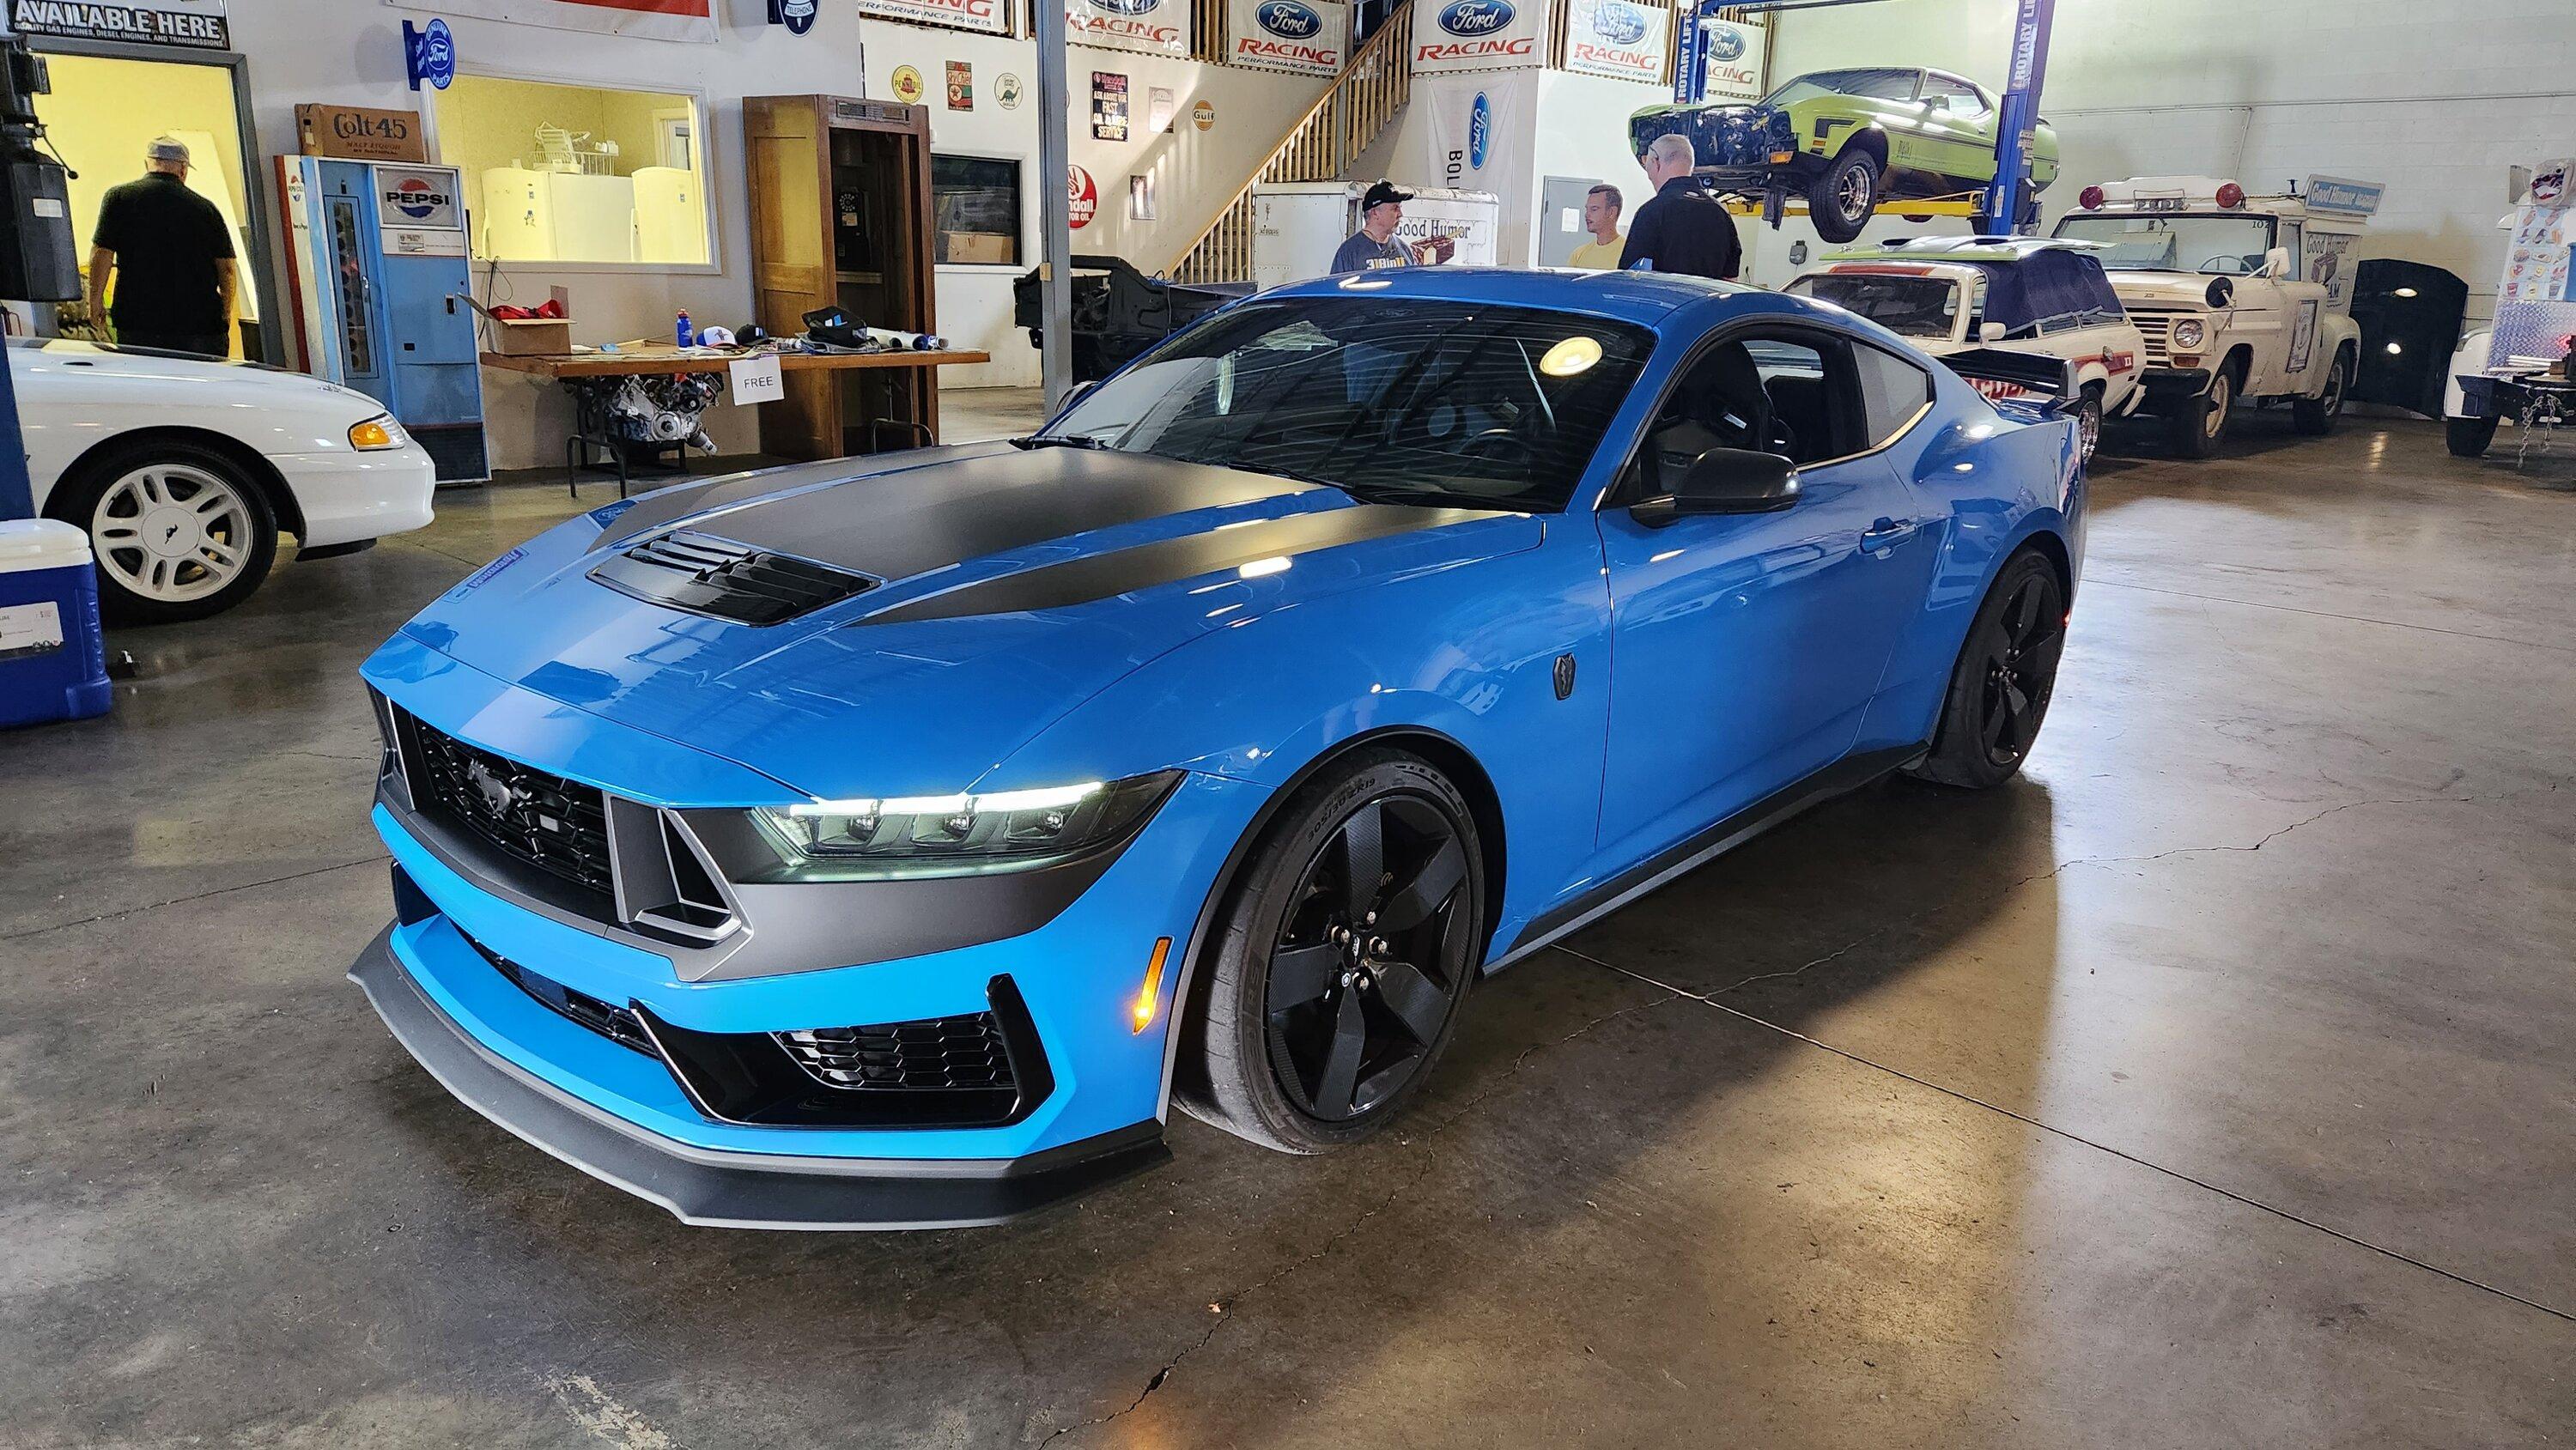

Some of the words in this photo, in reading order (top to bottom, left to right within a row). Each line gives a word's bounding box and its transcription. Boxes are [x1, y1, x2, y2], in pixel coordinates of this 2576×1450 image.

[787, 4, 812, 15] TELEPHONE
[859, 2, 949, 19] ERFORMANCE
[1269, 4, 1309, 33] Ford
[1453, 3, 1500, 30] Ford
[15, 0, 151, 33] AVAILABLE
[156, 12, 221, 39] HERE
[46, 25, 62, 33] GAS
[96, 30, 119, 39] DIESEL
[427, 21, 449, 41] GENUINE
[428, 43, 449, 63] Ford
[1237, 38, 1337, 65] RACING
[1417, 38, 1534, 61] RACING
[1574, 43, 1659, 70] RACING
[2014, 22, 2032, 81] ROTARY
[1237, 56, 1306, 70] PERFORMANCE
[1309, 65, 1338, 74] PARTS
[1632, 70, 1657, 79] PARTS
[1678, 47, 1690, 98] ROTARY
[1708, 65, 1755, 84] CING
[433, 72, 450, 85] PARTS
[1102, 100, 1119, 114] FAST
[1194, 111, 1215, 119] Gulf
[334, 112, 375, 139] Colt
[376, 118, 407, 140] 45
[1097, 125, 1124, 140] SERVICE
[1473, 108, 1487, 154] Ford
[1446, 150, 1462, 190] BOL
[386, 191, 450, 206] PEPSI
[1069, 198, 1094, 212] ndall
[1080, 213, 1091, 221] OIL
[1431, 220, 1471, 239] Humor
[744, 376, 774, 389] FREE
